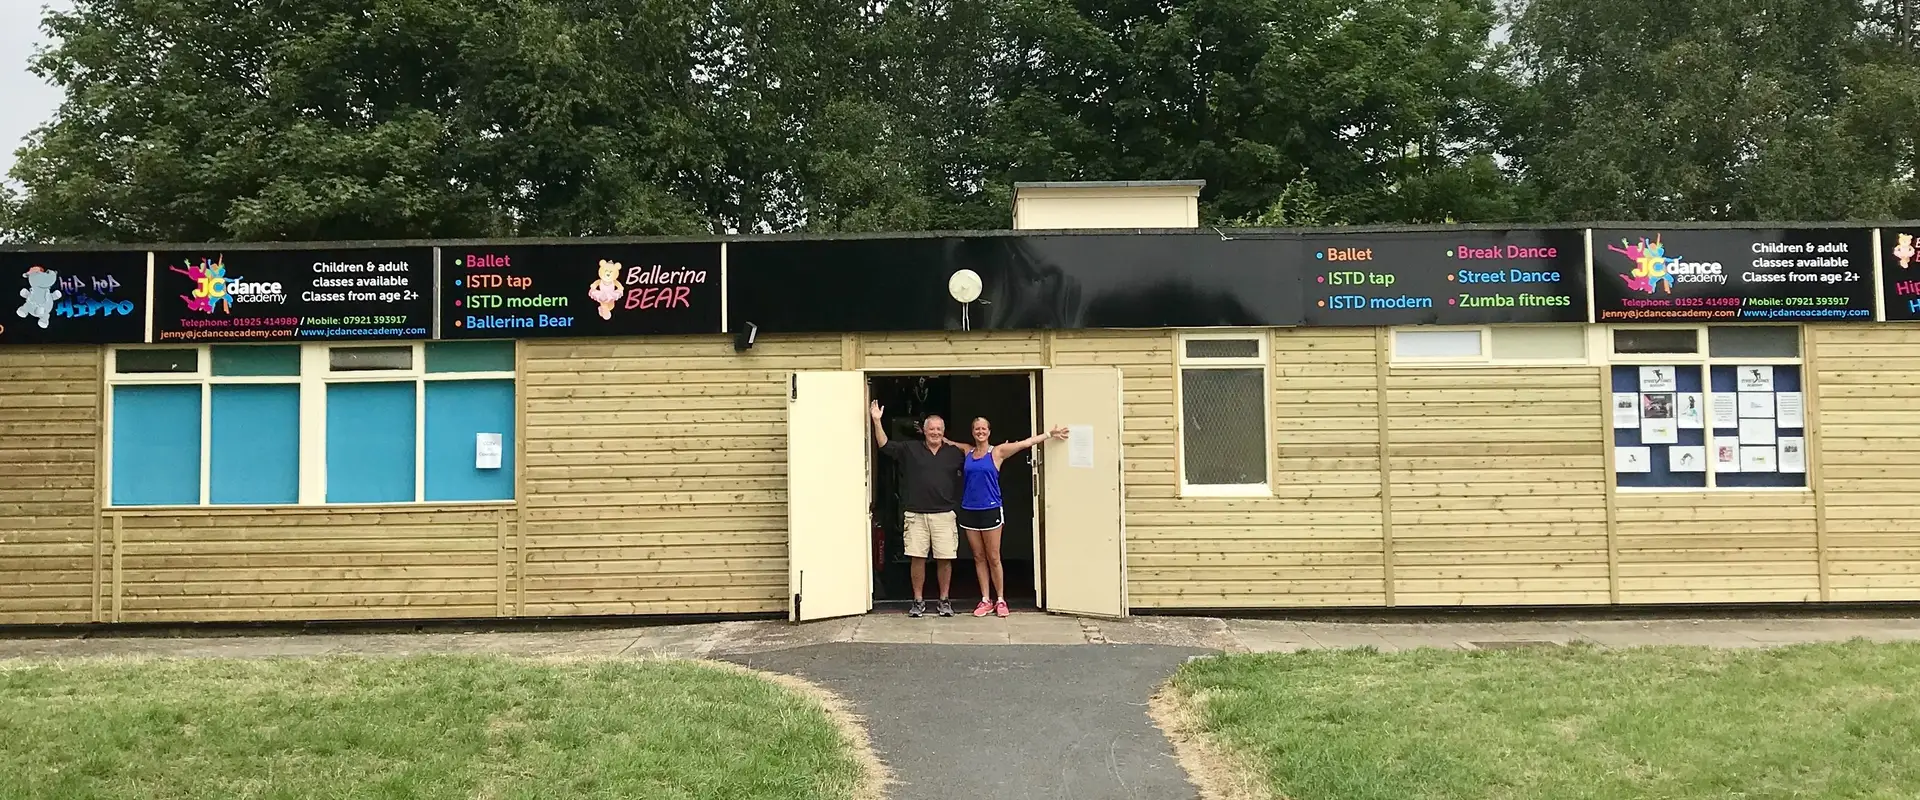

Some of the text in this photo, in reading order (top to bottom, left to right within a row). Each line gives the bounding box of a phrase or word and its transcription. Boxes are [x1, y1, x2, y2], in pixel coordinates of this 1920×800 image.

[1327, 247, 1373, 261] Ballet
[1458, 245, 1557, 259] Break Dance
[1751, 242, 1849, 253] Children & adult
[312, 261, 409, 273] Children & adult
[466, 254, 511, 268] Ballet
[1752, 256, 1849, 268] classes available
[312, 275, 409, 287] classes available
[625, 264, 707, 285] Ballerina
[1328, 271, 1395, 287] ISTD tap
[1458, 269, 1561, 283] Street Dance
[1677, 273, 1728, 285] academy
[1742, 271, 1861, 284] Classes from age 2+
[466, 274, 532, 290] ISTD tap
[236, 293, 287, 304] academy
[301, 289, 420, 303] Classes from age 2+
[466, 293, 568, 308] ISTD modern
[624, 286, 691, 310] BEAR
[1329, 294, 1433, 309] ISTD modern
[1459, 293, 1571, 307] Zumba fitness
[1621, 297, 1850, 308] Telephone: 01925 414989 / Mobile: 07921 393917
[56, 298, 134, 318] HIPPO
[1601, 308, 1870, 319] jenny@jcdanceacademy.com / www.jcdanceacademy.com
[180, 315, 407, 328] Telephone: 01925 414989 / Mobile: 07921 393917
[466, 313, 574, 329] Ballerina Bear
[160, 326, 426, 339] jenny@jcdanceacademy.com / www.jcdanceacademy.com
